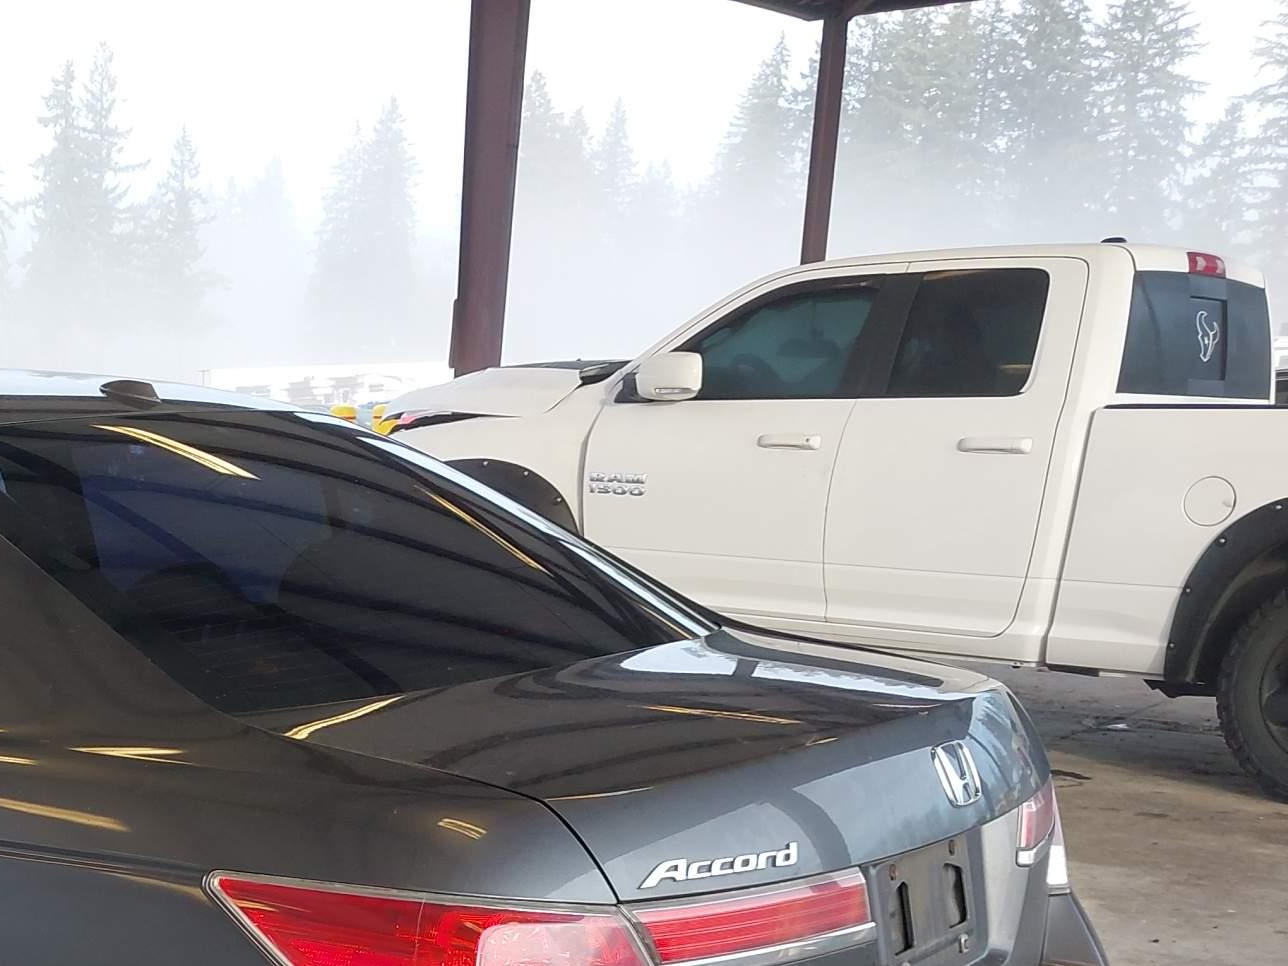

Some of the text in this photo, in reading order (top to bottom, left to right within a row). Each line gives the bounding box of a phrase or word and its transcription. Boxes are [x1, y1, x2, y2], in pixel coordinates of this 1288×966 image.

[588, 472, 647, 484] RAM
[588, 484, 646, 496] 1500
[638, 841, 799, 889] Accord
